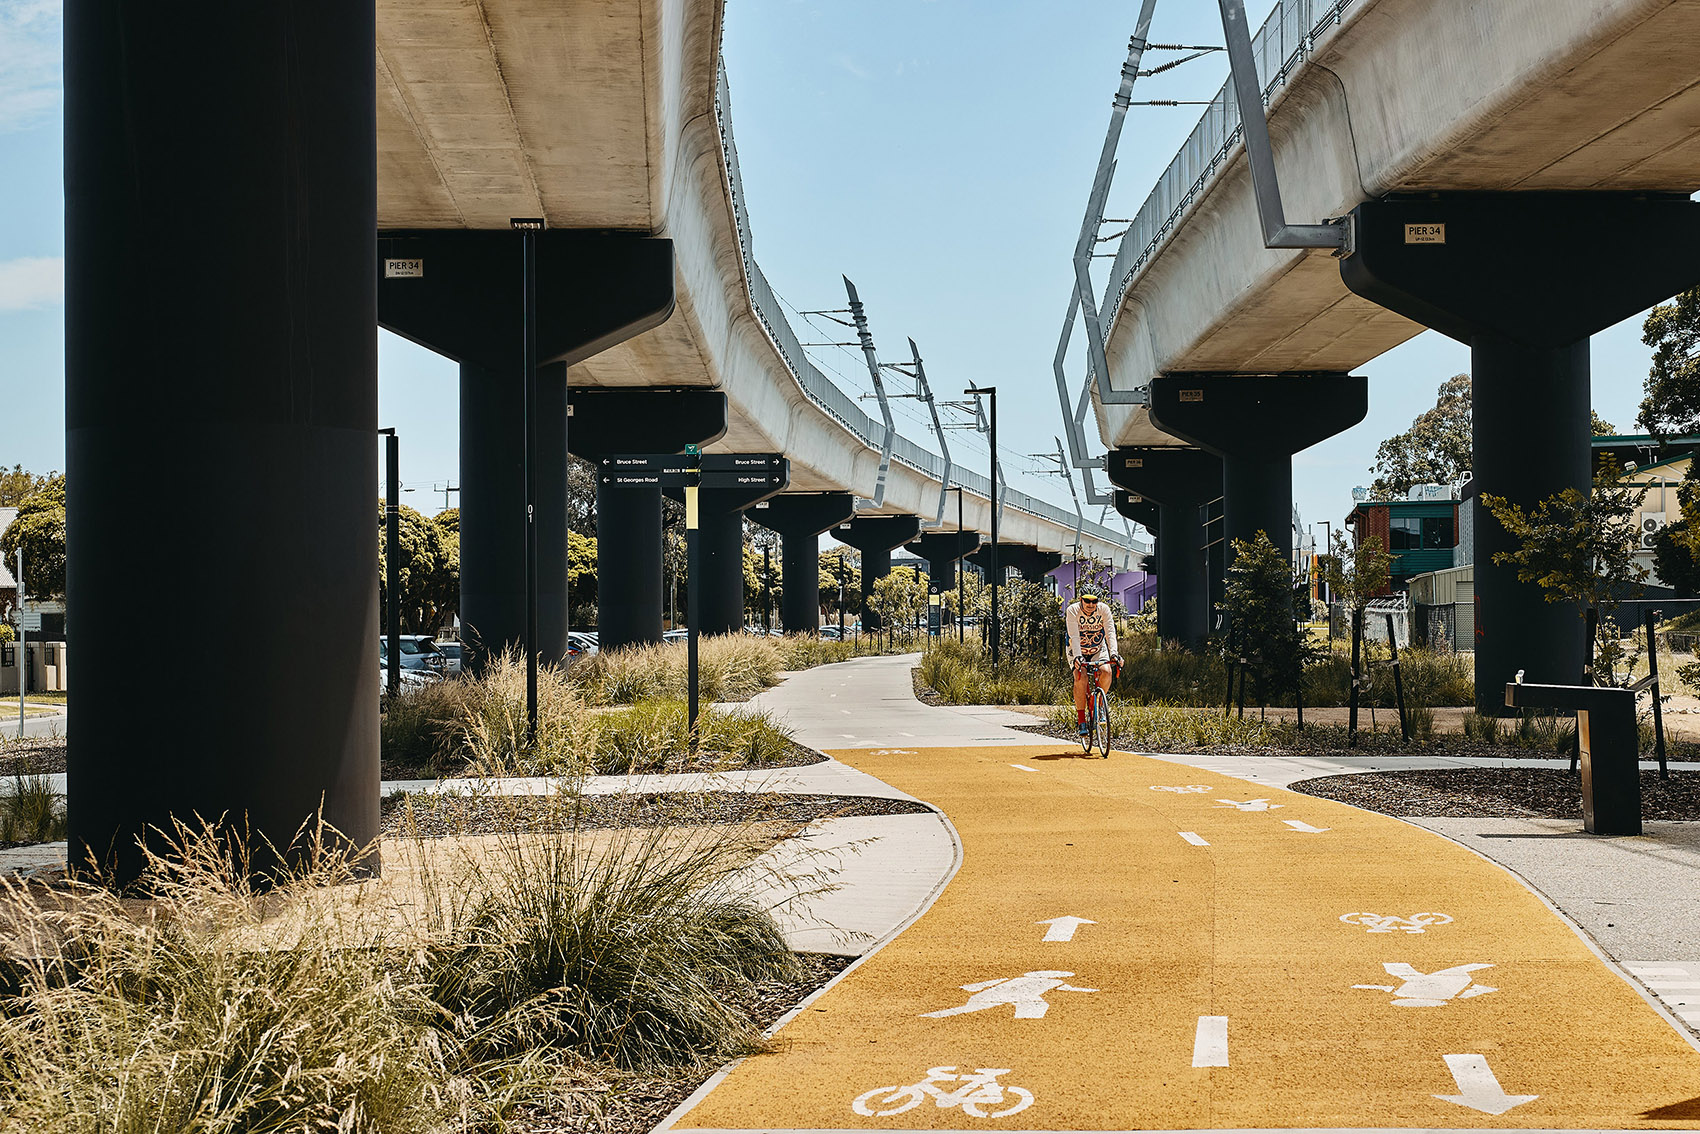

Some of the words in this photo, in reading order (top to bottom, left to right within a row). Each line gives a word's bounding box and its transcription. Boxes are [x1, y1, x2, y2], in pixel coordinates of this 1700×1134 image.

[1409, 226, 1428, 235] PIER
[1429, 226, 1441, 235] 34
[389, 261, 407, 270] PIER
[408, 261, 419, 270] 34
[738, 476, 751, 484] High
